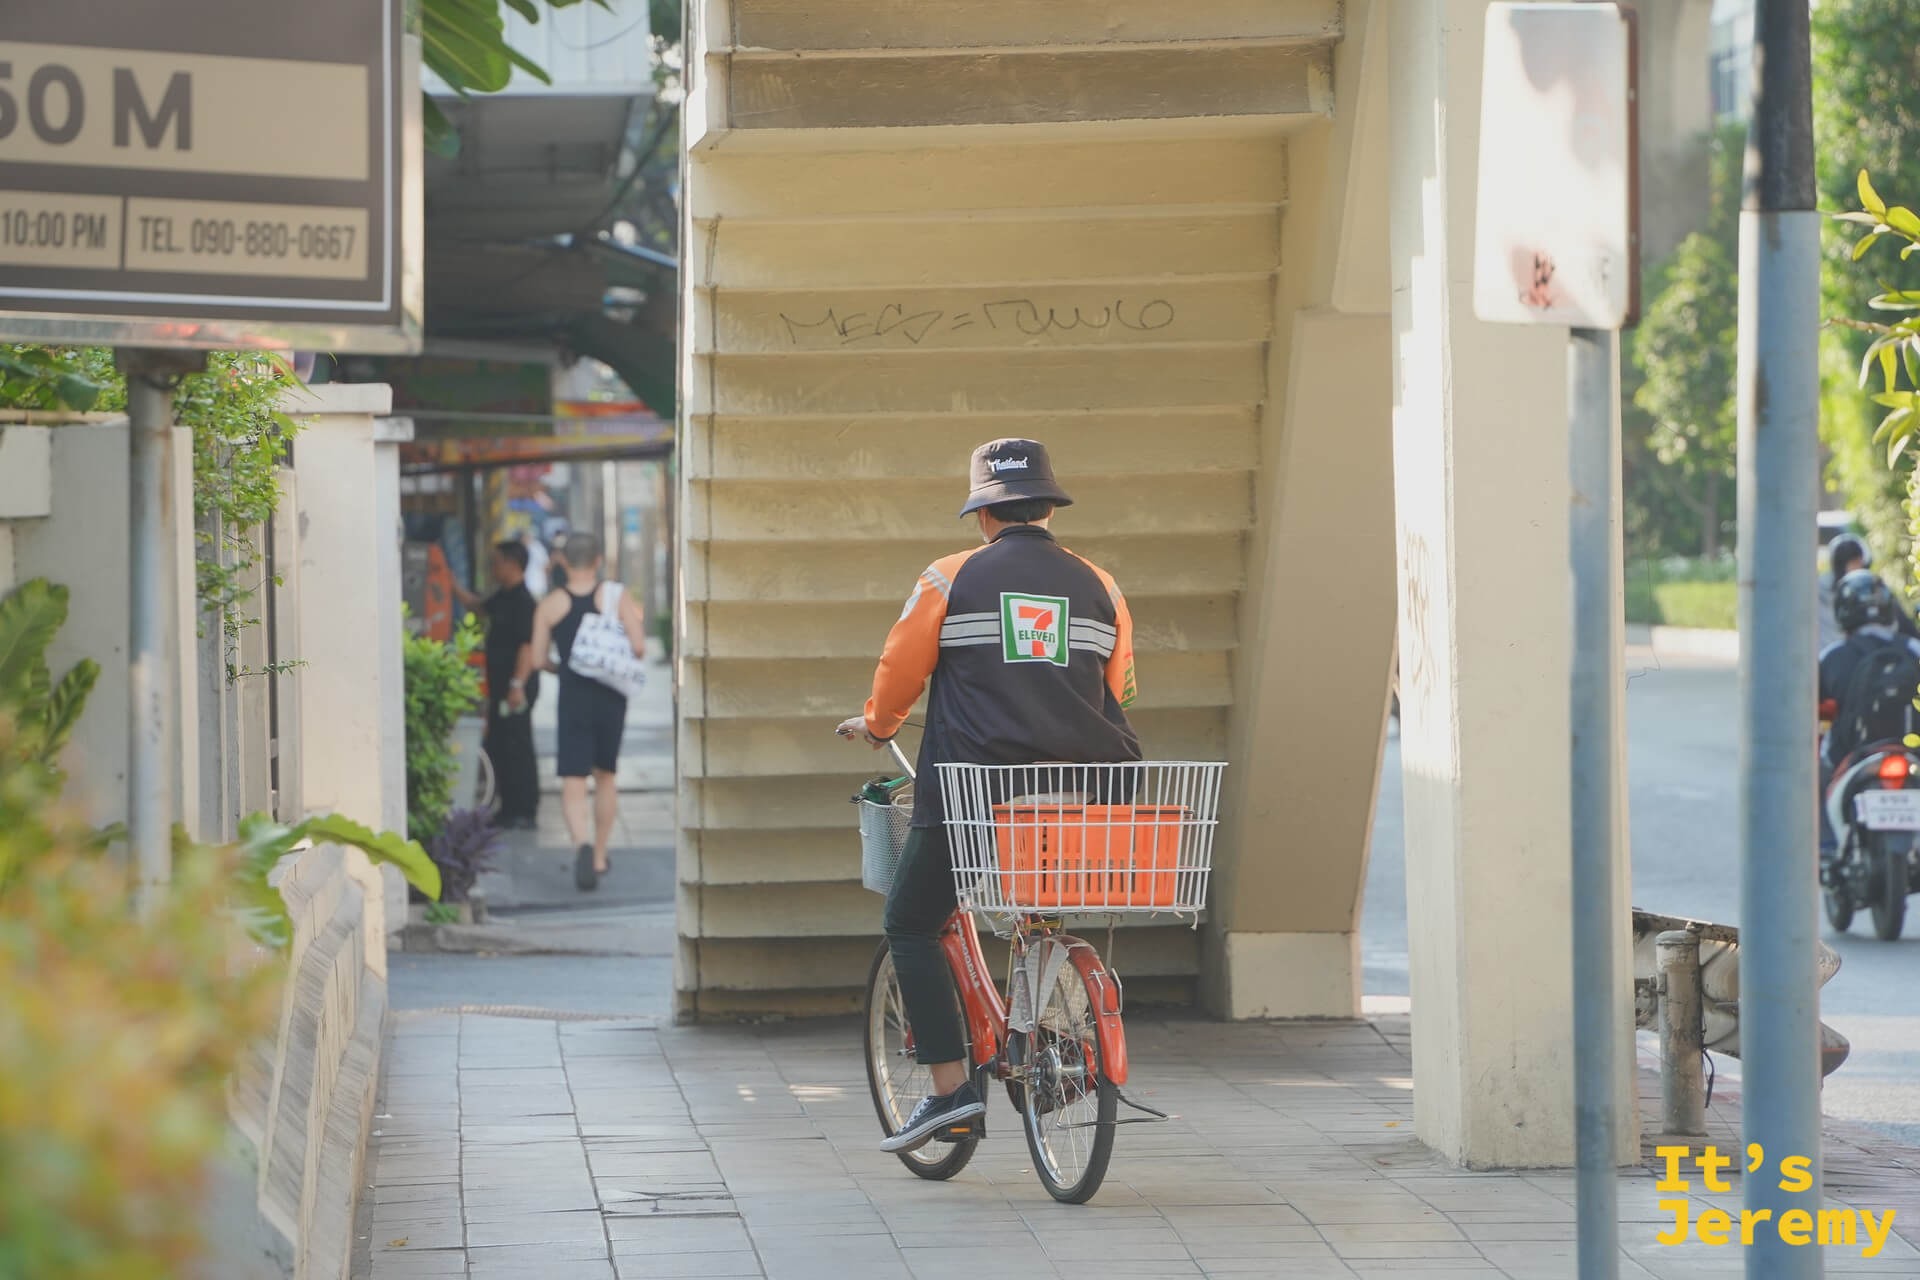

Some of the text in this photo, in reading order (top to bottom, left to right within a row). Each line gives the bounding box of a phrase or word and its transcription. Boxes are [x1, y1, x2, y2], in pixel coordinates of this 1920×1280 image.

[112, 66, 193, 152] M
[3, 209, 107, 249] 10:00 PM
[139, 215, 356, 260] TEL. 090-880-0667
[1018, 605, 1053, 657] 7
